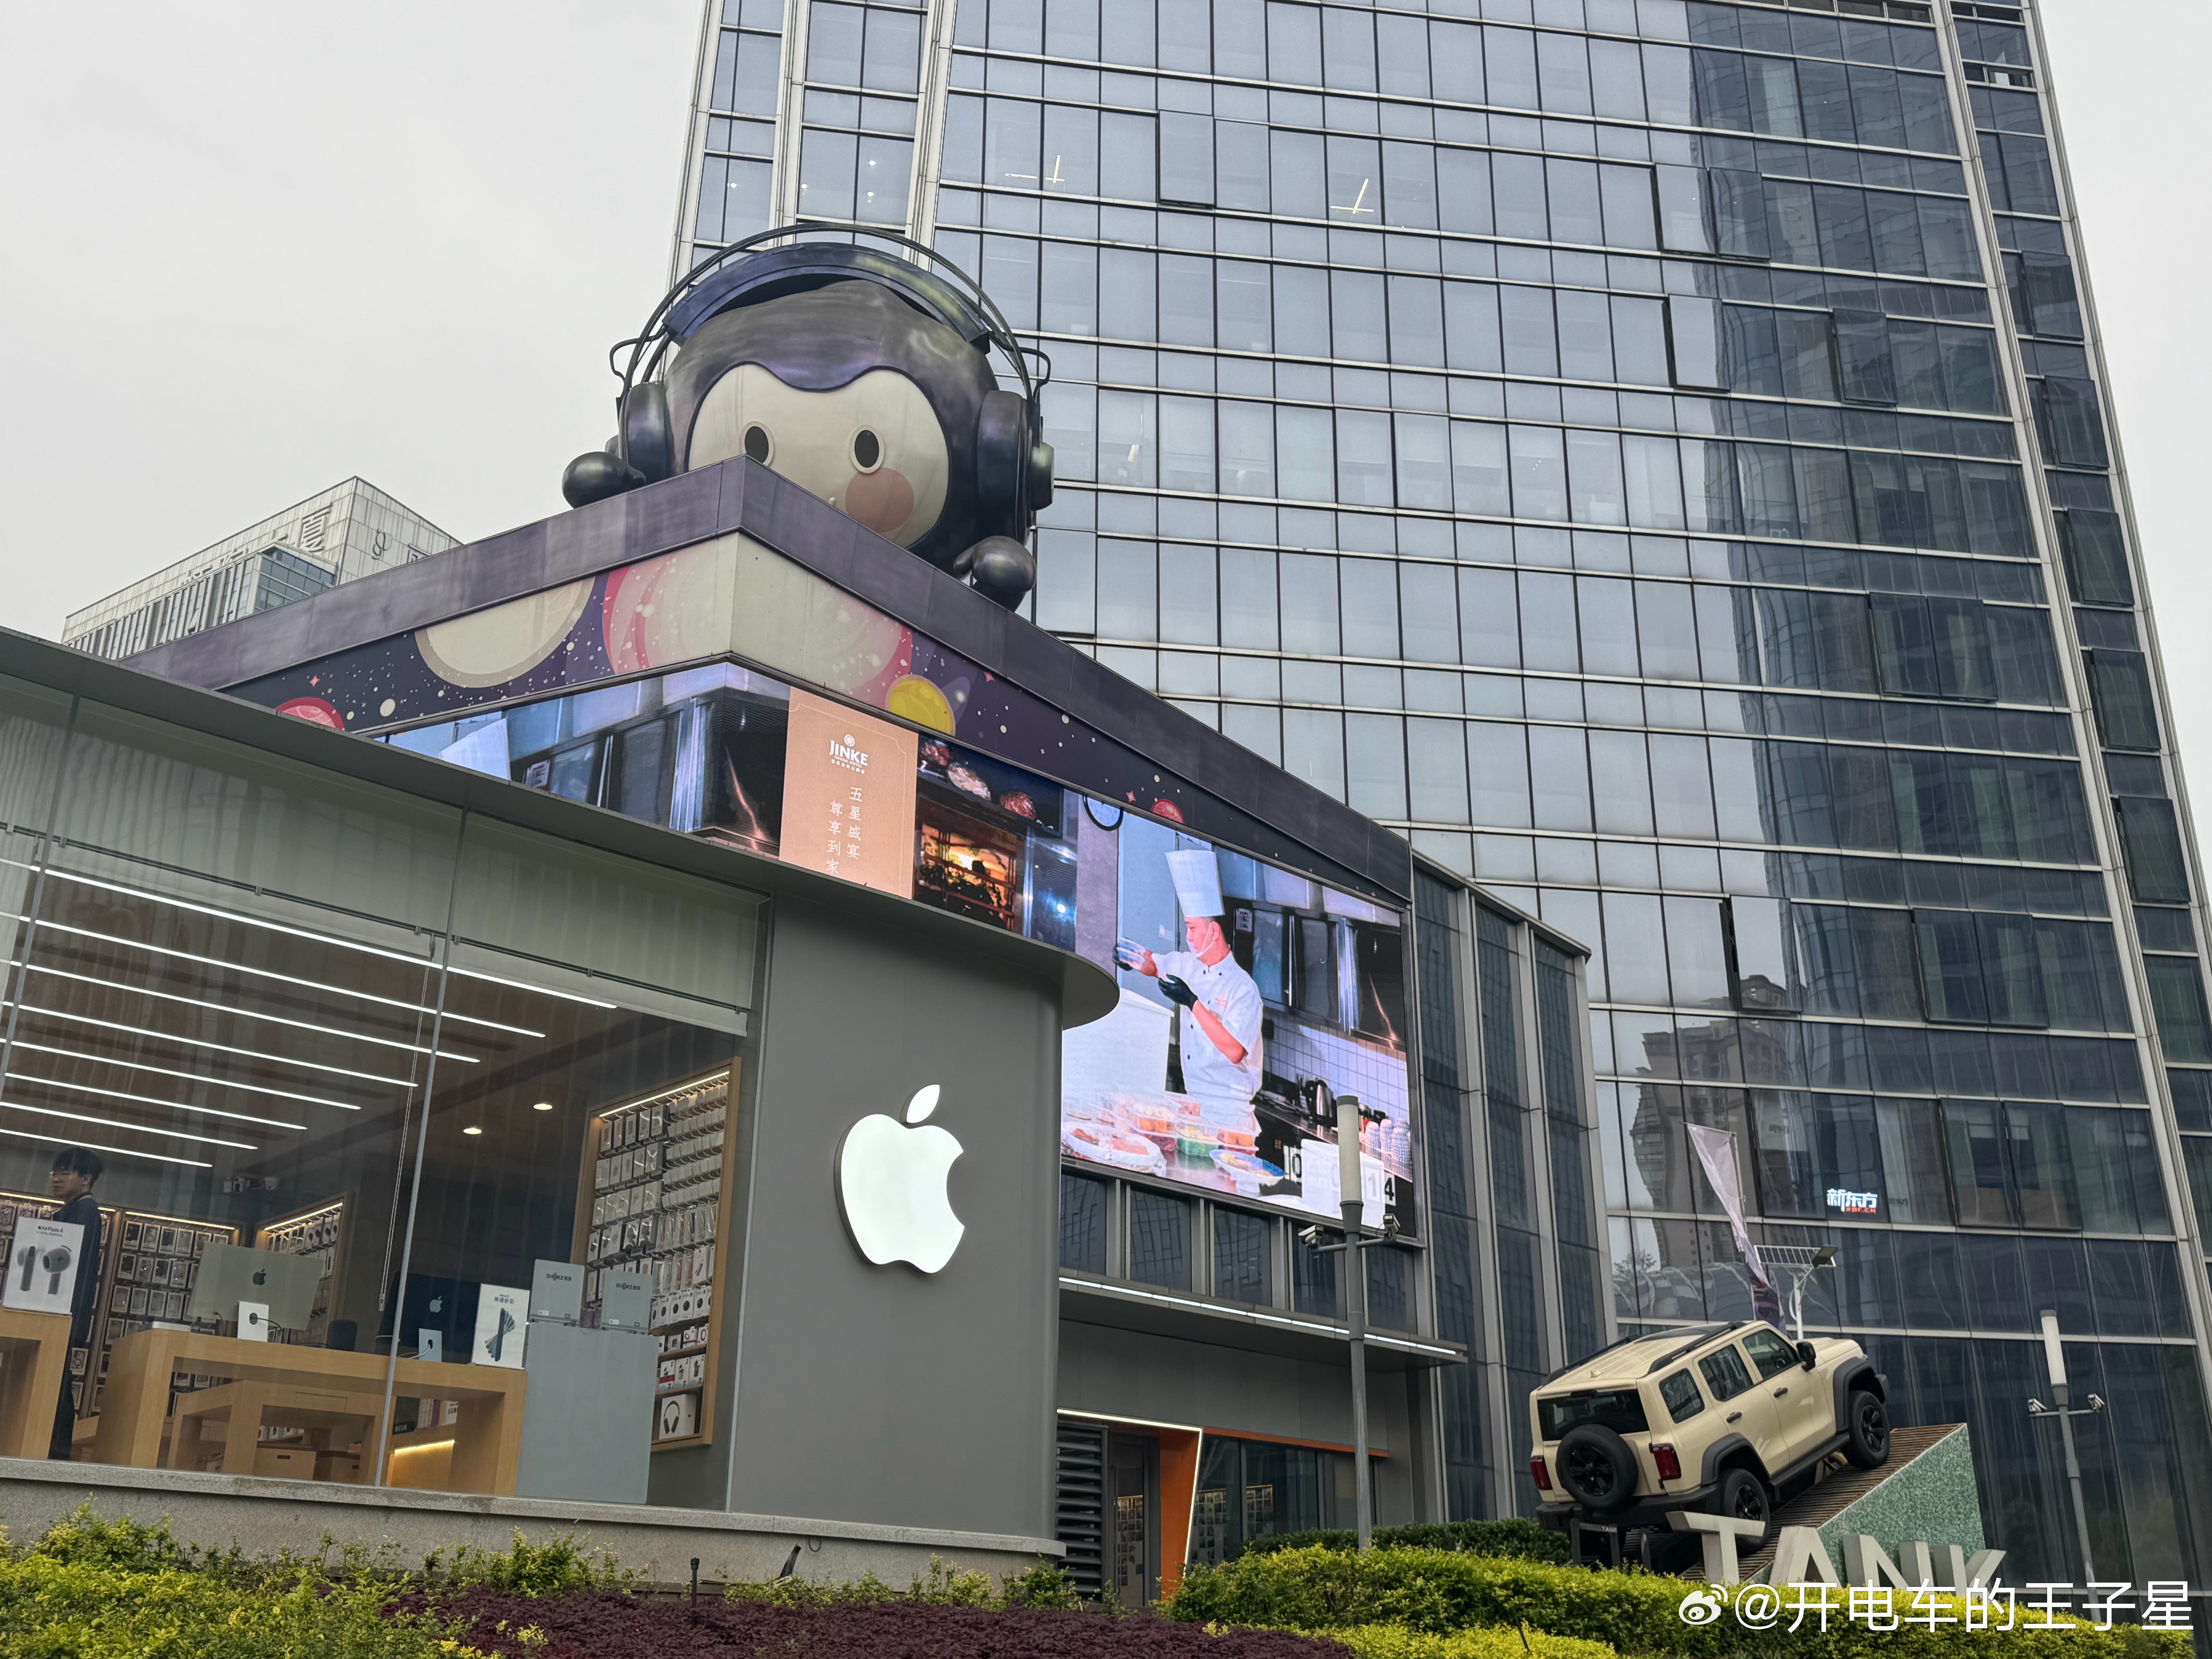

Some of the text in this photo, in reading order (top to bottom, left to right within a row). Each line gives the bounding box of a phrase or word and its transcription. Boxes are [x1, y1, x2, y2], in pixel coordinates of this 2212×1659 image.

[829, 740, 868, 766] JINKE
[826, 801, 843, 874] 尊享到家
[1827, 1188, 1878, 1212] 新东方
[1665, 1511, 2007, 1596] TANK
